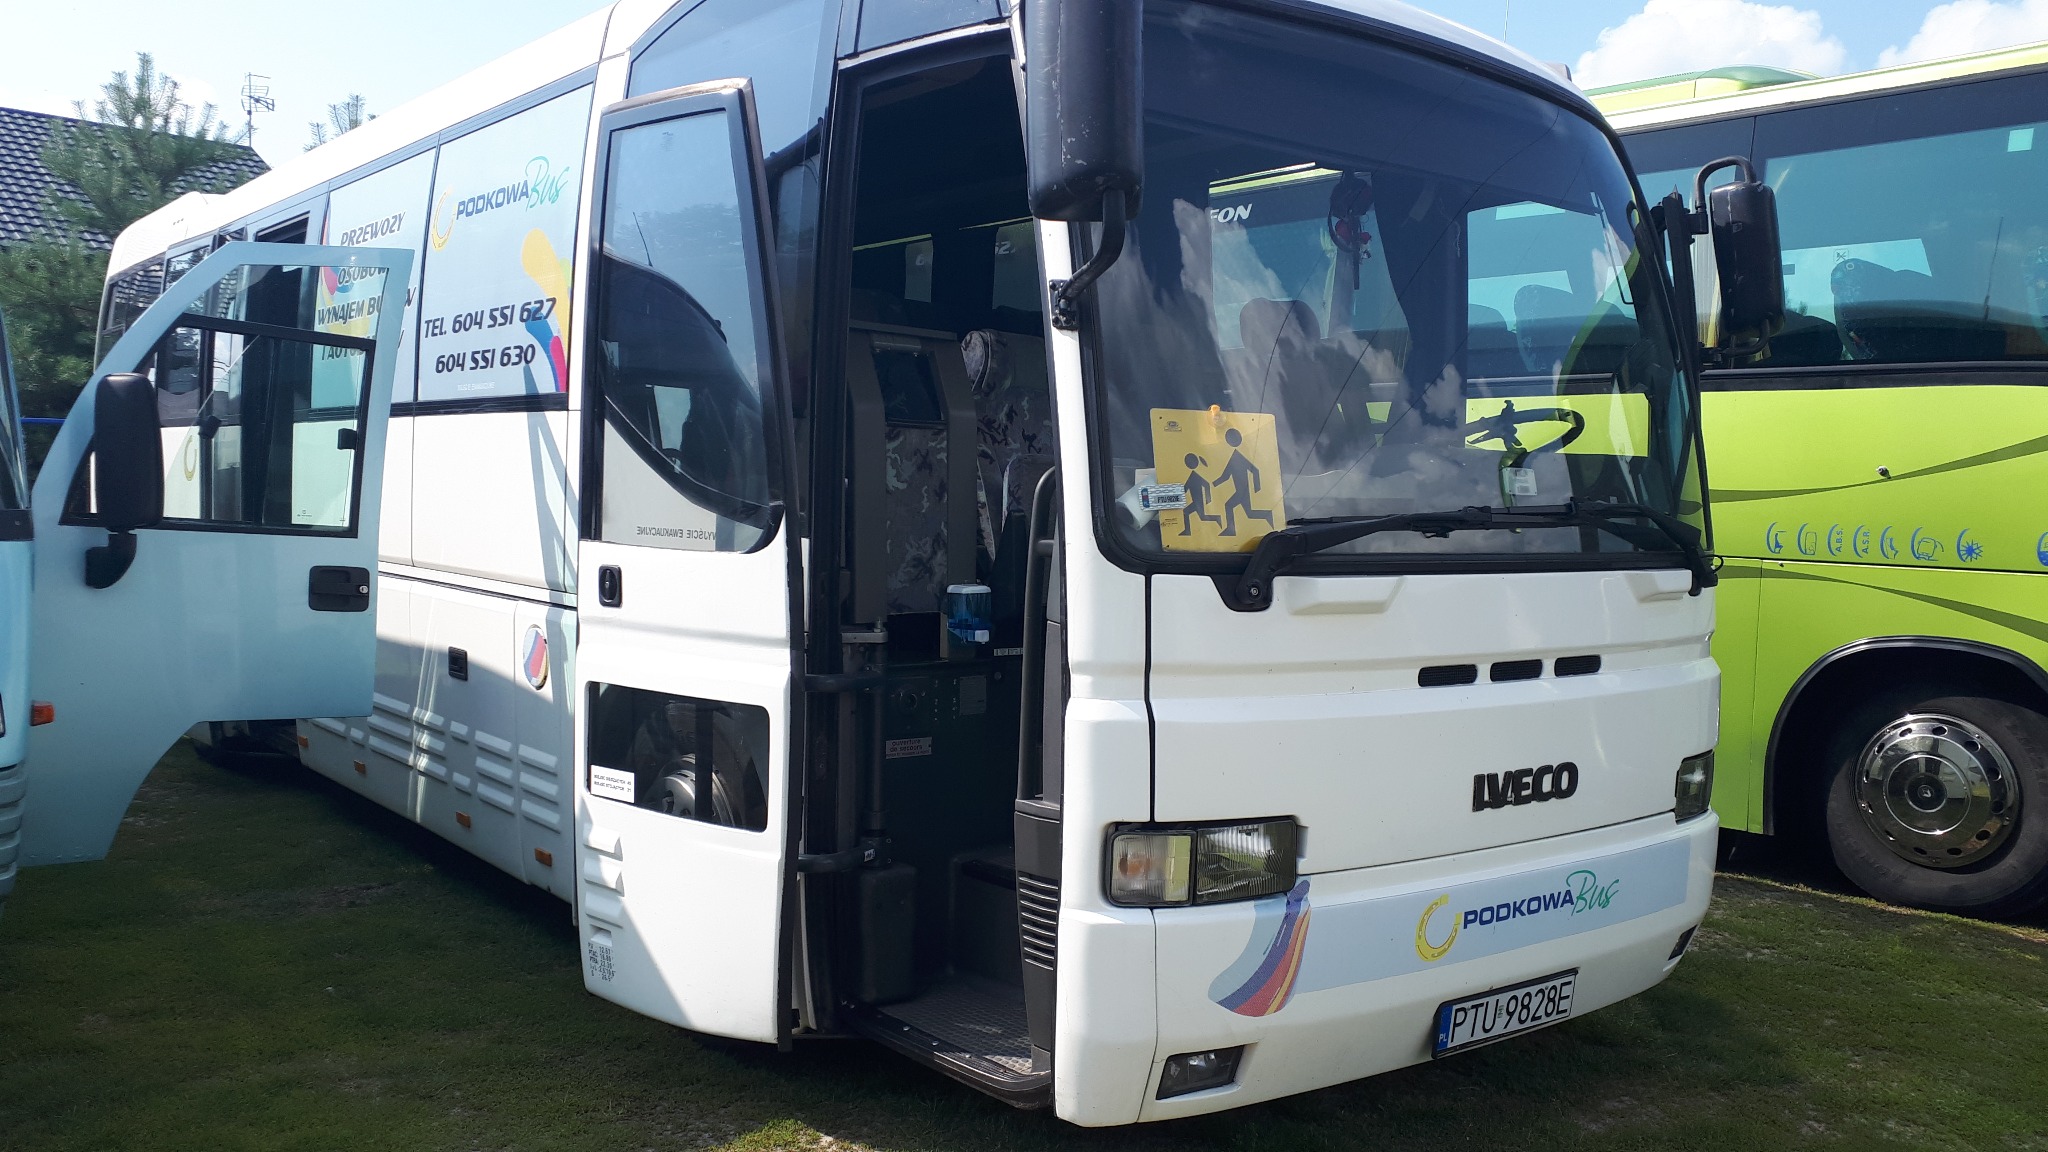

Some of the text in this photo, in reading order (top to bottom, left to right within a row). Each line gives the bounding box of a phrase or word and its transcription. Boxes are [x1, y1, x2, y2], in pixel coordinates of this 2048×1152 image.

[456, 180, 529, 220] PODKOWA
[318, 299, 365, 325] WYNAJEM
[424, 317, 447, 338] TEL.
[451, 310, 485, 334] 604
[519, 297, 557, 323] 627
[435, 352, 467, 374] 604
[500, 343, 536, 367] 630
[1835, 528, 1844, 553] A.B.S.
[1861, 529, 1870, 555] A.S.R.
[1472, 761, 1579, 812] IVECO
[1463, 889, 1575, 929] PODKOWA
[1438, 1032, 1448, 1044] PL
